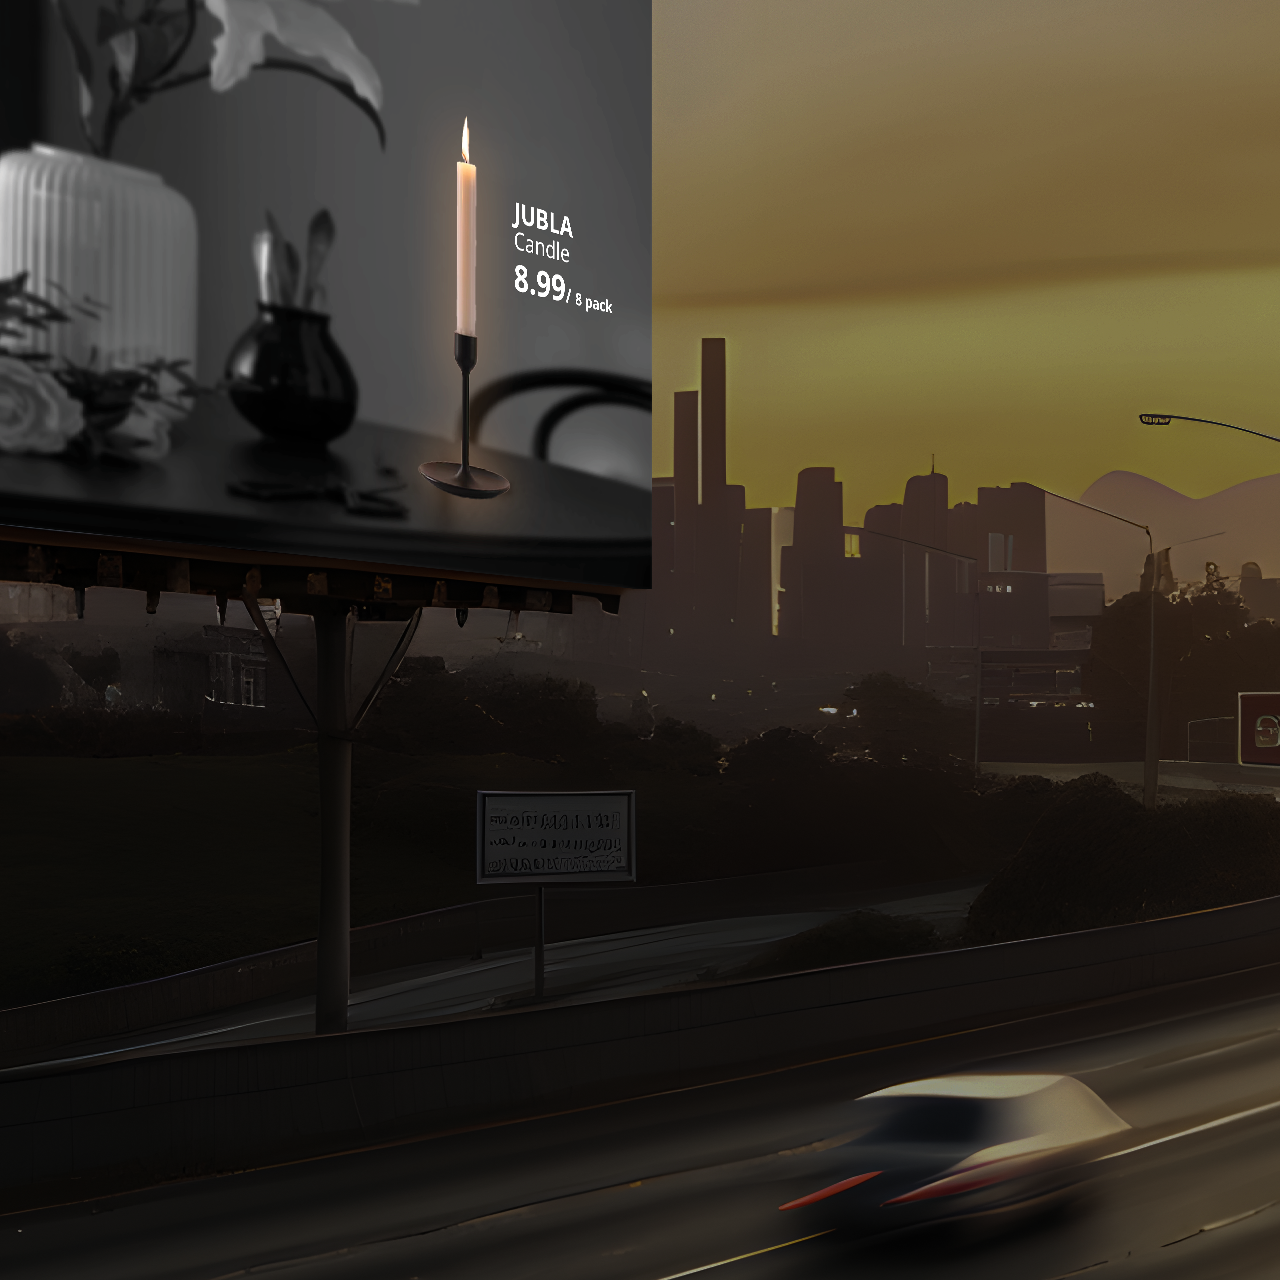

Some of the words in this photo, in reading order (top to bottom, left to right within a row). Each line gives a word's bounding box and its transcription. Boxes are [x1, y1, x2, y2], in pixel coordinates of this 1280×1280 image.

[511, 202, 574, 239] JUBLA
[514, 231, 570, 263] Candle
[585, 297, 613, 314] pack
